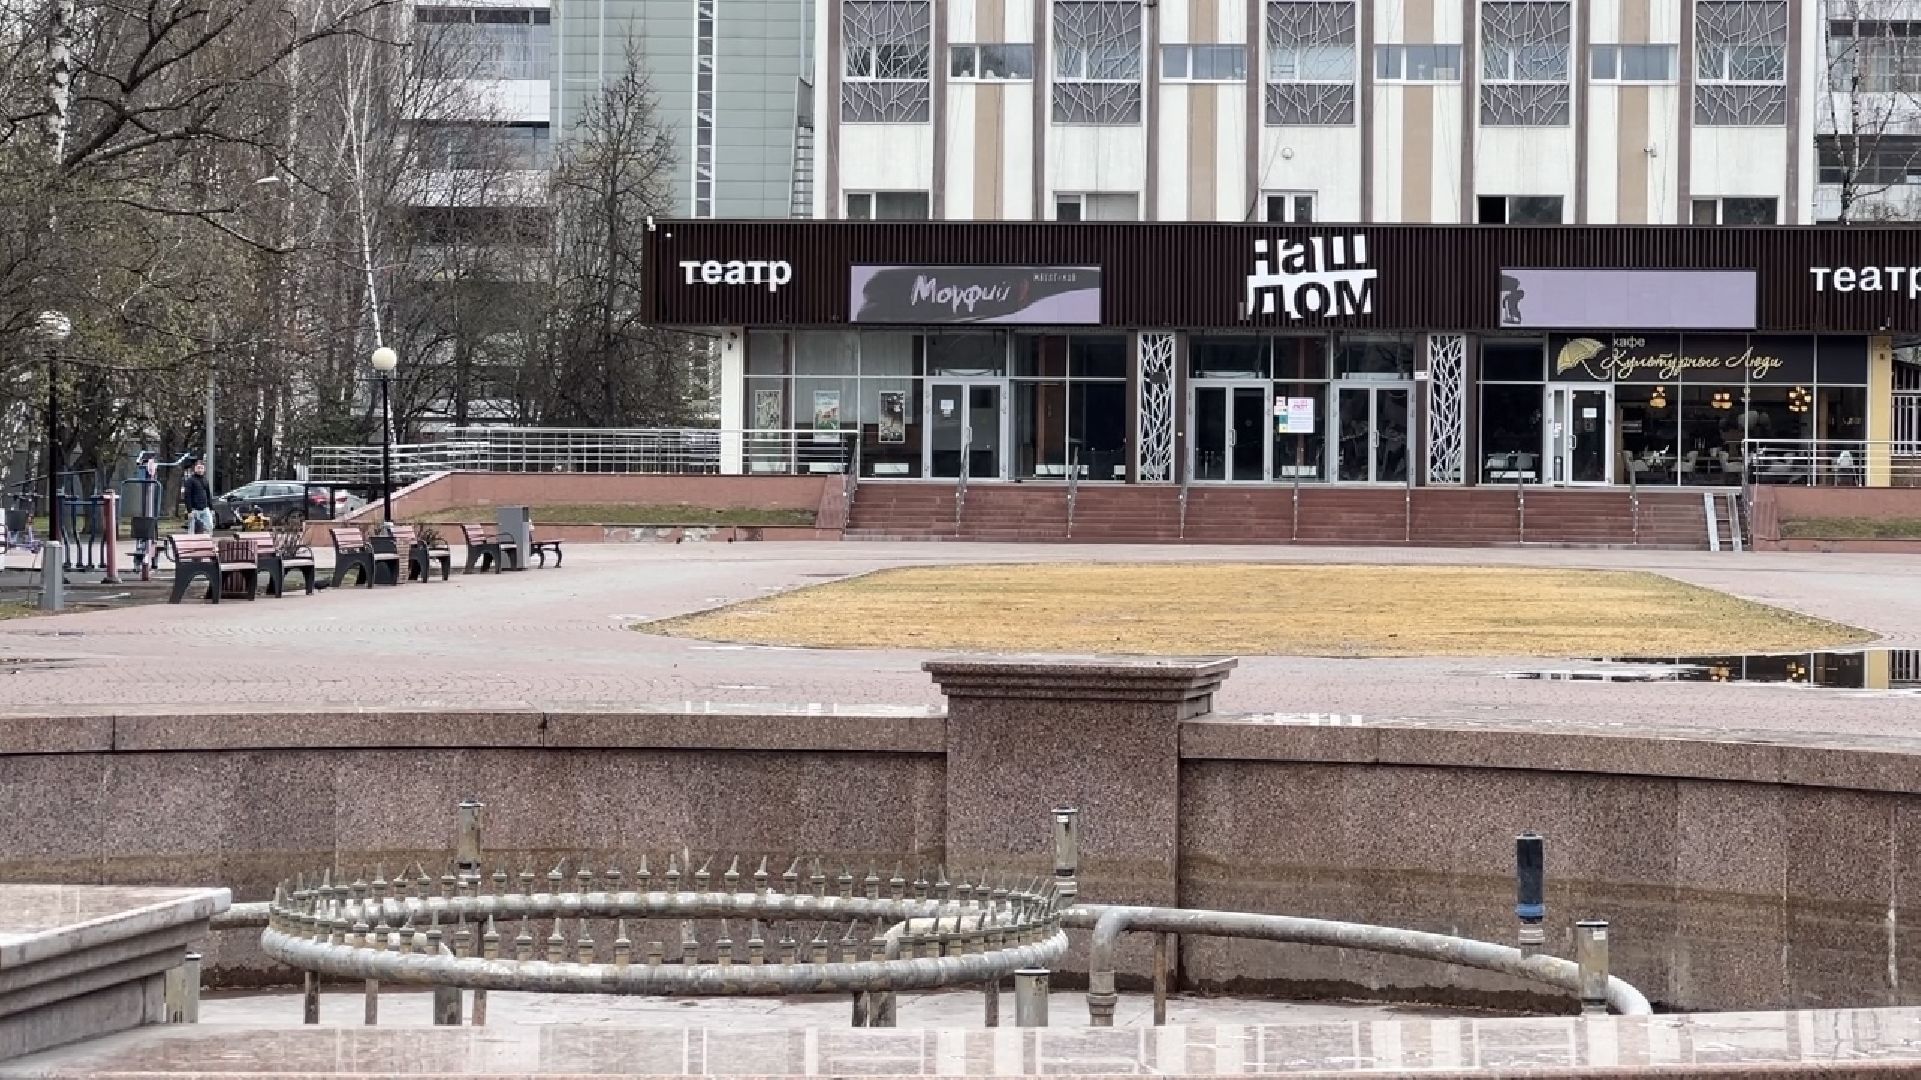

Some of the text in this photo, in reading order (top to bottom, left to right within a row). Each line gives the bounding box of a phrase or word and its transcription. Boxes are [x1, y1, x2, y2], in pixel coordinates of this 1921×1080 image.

[679, 260, 792, 293] театр
[1613, 336, 1645, 348] кафе
[1600, 347, 1783, 379] Культурные Люди
